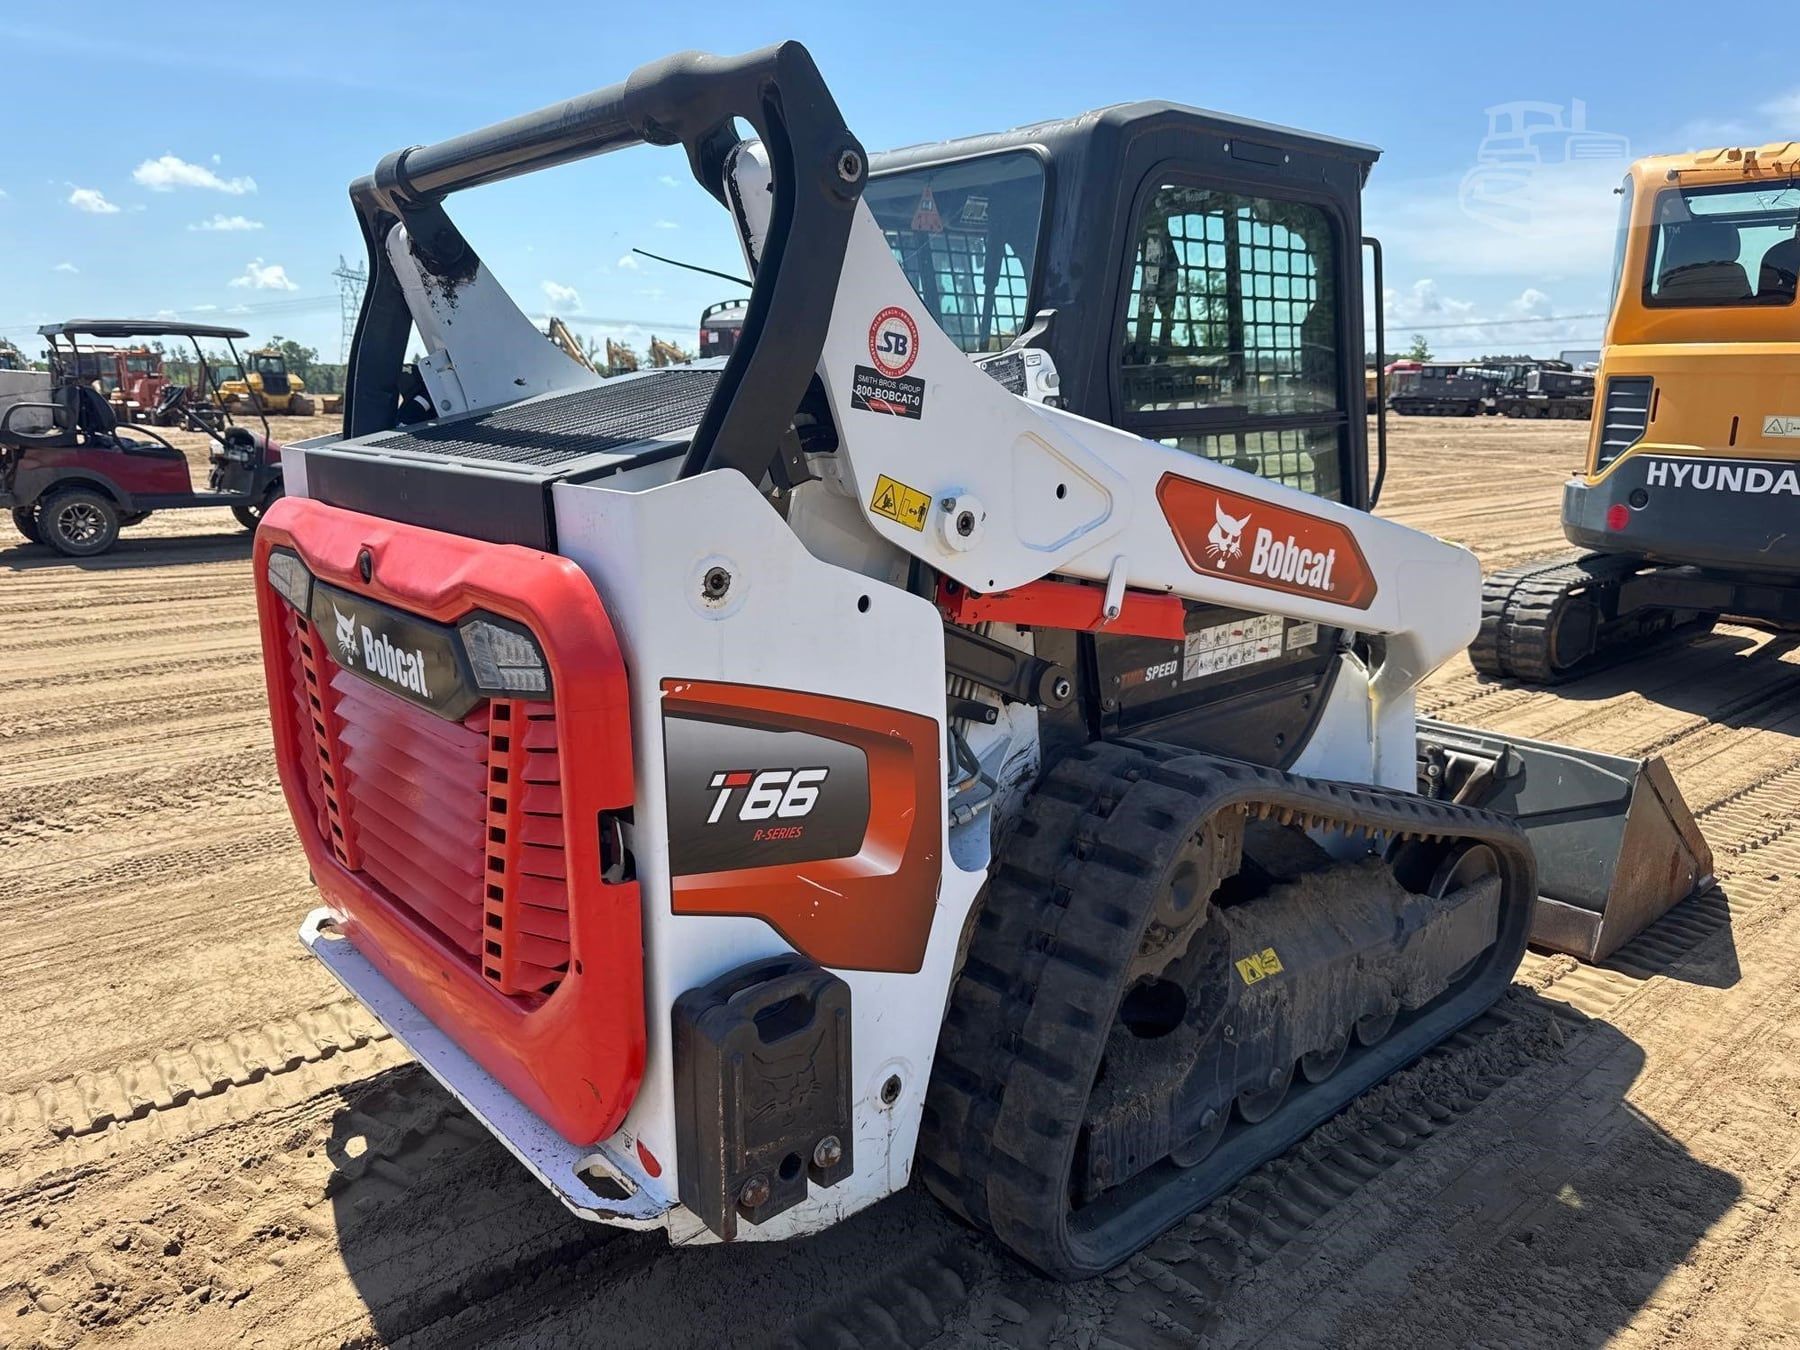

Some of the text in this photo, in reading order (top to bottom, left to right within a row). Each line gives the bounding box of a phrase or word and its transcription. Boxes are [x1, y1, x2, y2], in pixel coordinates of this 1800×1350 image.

[877, 331, 908, 356] SB
[856, 384, 920, 406] 800-BOBCAT-0
[857, 374, 878, 384] SMITH
[899, 383, 921, 393] GROUP
[1249, 526, 1335, 591] Bobcat
[361, 625, 429, 699] Bobcat
[1145, 660, 1178, 682] SPEED
[706, 768, 829, 824] T66
[753, 826, 803, 842] R-SERIES
